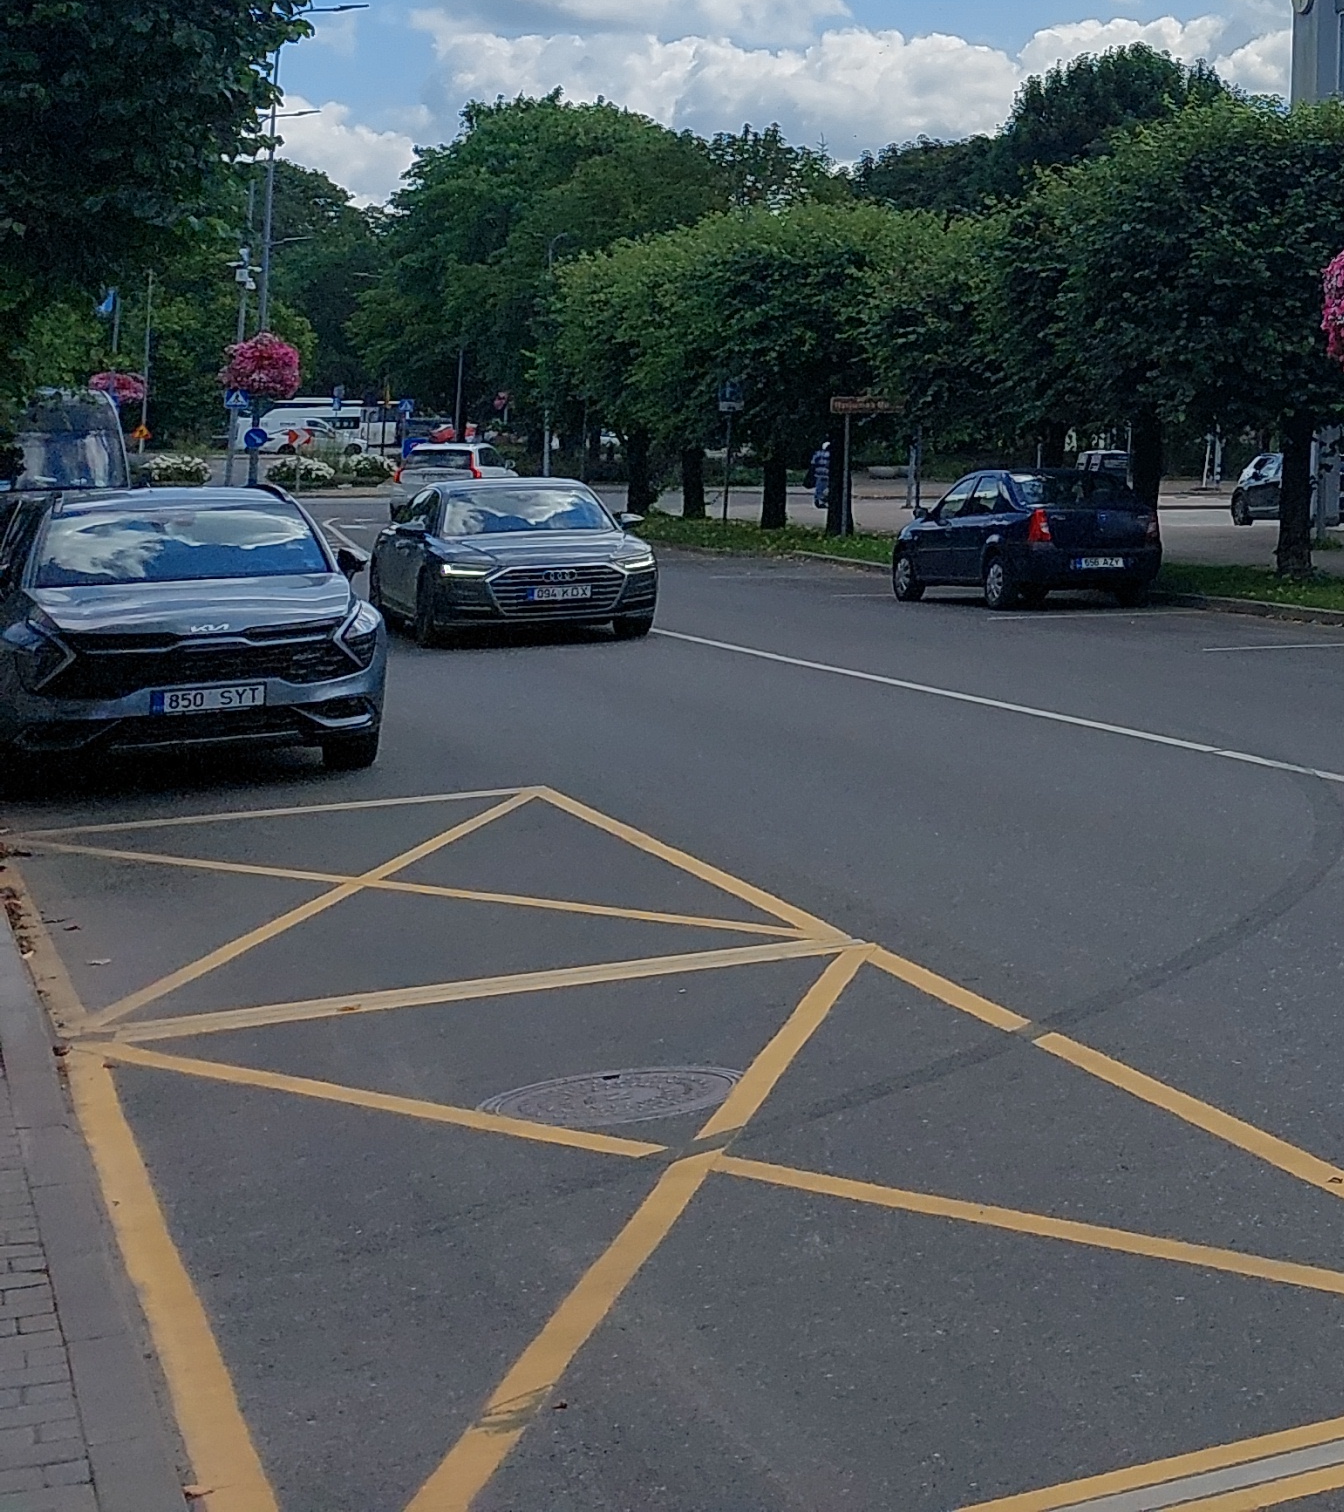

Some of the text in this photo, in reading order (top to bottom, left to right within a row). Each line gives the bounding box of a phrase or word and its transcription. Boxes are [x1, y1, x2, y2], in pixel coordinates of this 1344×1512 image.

[1102, 557, 1120, 567] AZY
[536, 586, 589, 599] 094 KDX
[168, 687, 260, 710] 850 SYT
